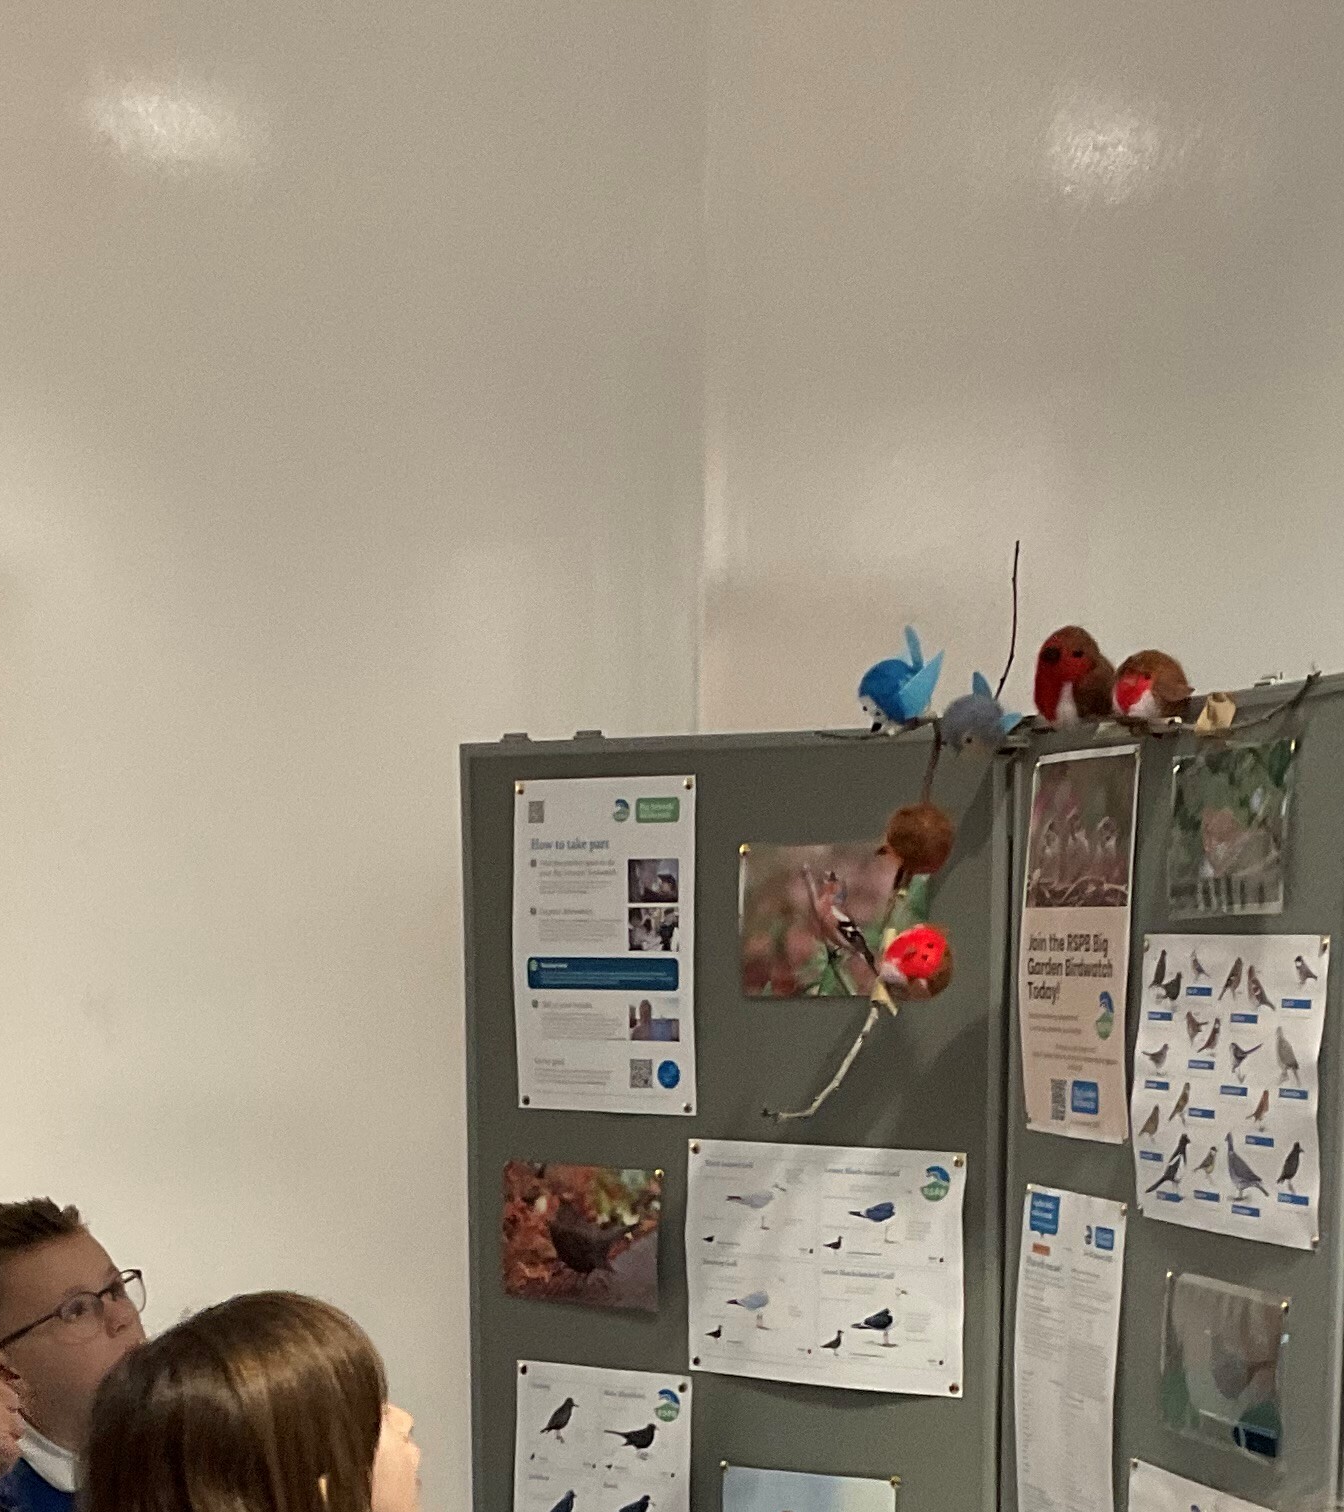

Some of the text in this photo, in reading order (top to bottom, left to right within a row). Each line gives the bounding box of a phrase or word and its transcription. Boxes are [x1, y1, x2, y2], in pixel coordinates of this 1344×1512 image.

[531, 837, 552, 851] How
[555, 839, 566, 850] to
[1029, 932, 1108, 958] Join the RSPB Big
[1028, 957, 1113, 978] Garden Birdwatch
[1027, 981, 1061, 1006] Today!
